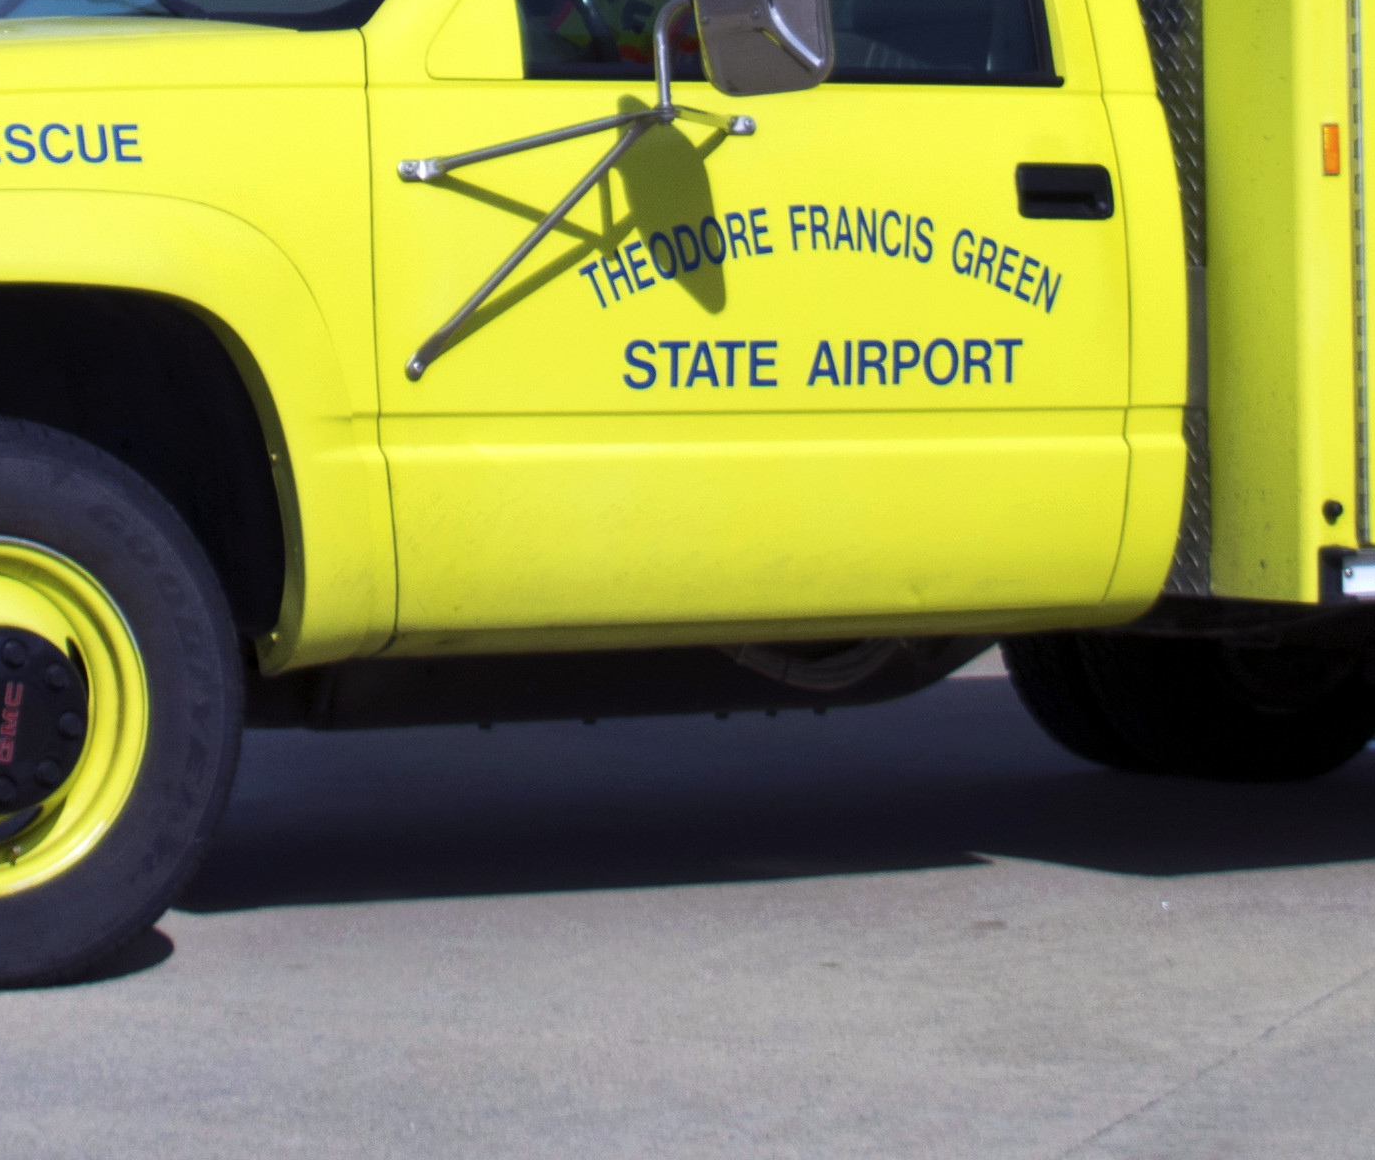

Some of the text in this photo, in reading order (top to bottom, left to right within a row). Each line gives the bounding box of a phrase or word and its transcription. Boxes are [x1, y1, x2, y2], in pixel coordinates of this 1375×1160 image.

[579, 204, 1061, 313] THEODORE FRANCIS GREEN
[623, 338, 1023, 390] STATE AIRPORT
